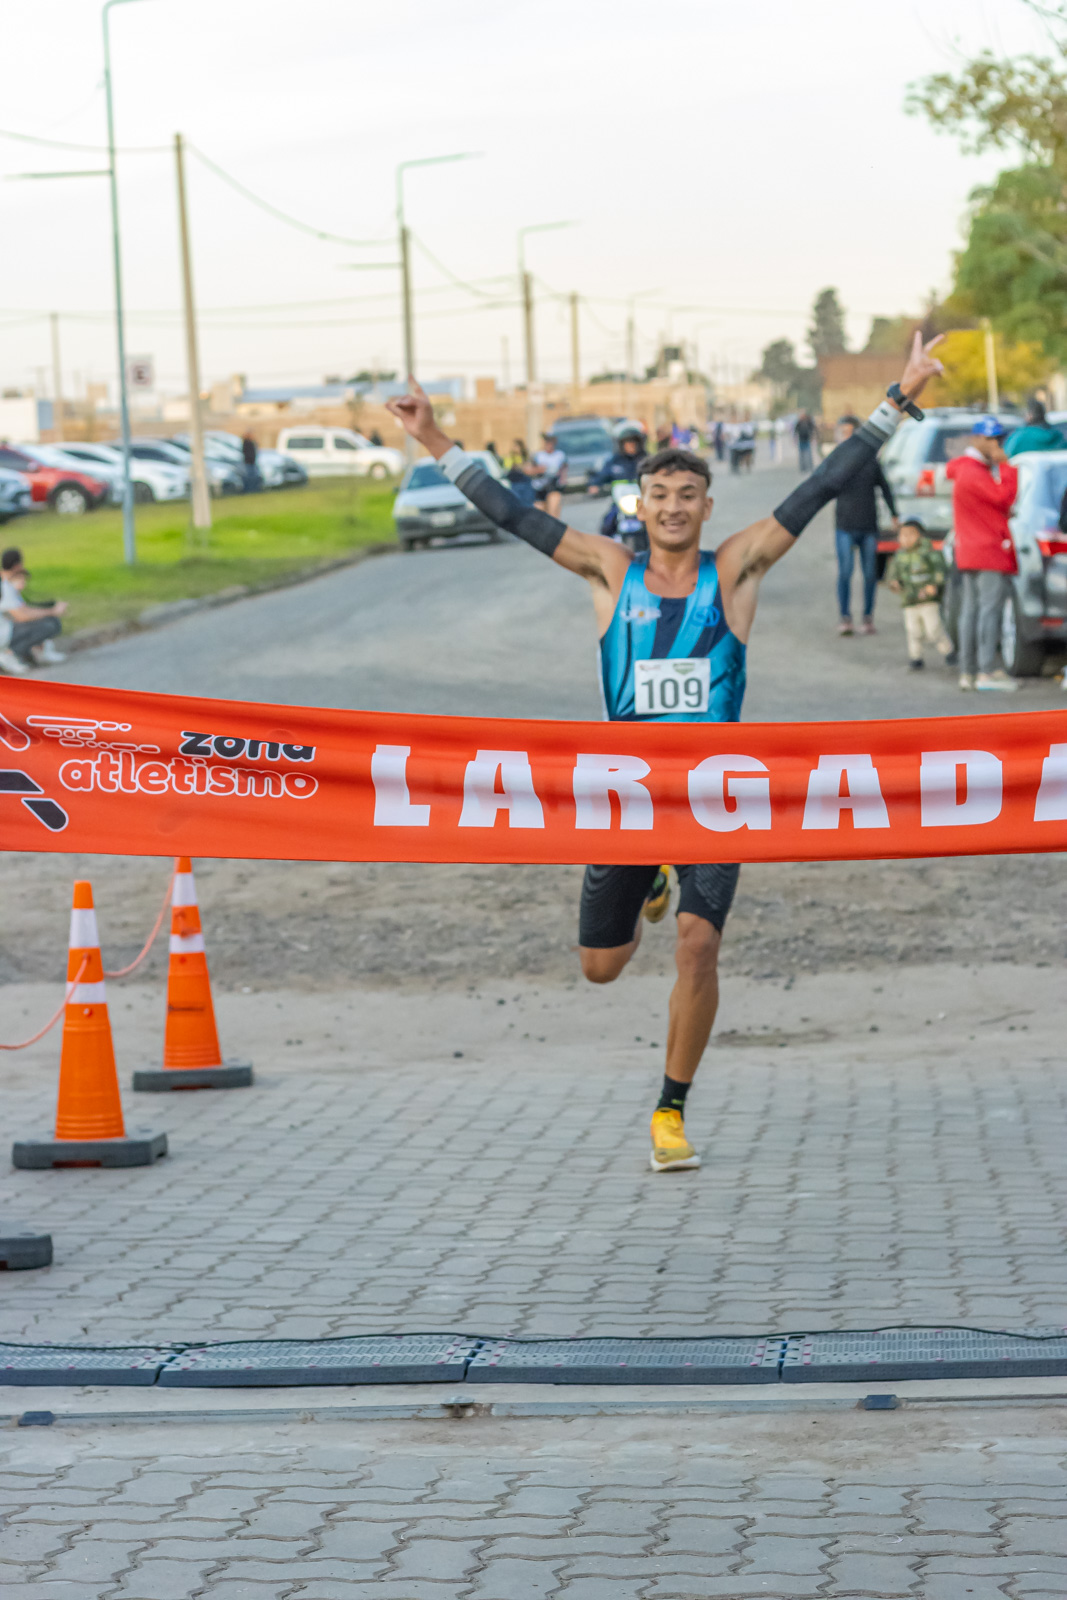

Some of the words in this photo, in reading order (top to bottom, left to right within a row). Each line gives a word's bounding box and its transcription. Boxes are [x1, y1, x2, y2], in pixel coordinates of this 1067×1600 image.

[641, 677, 703, 709] 109
[178, 731, 316, 762] zona
[59, 751, 319, 800] atletismo
